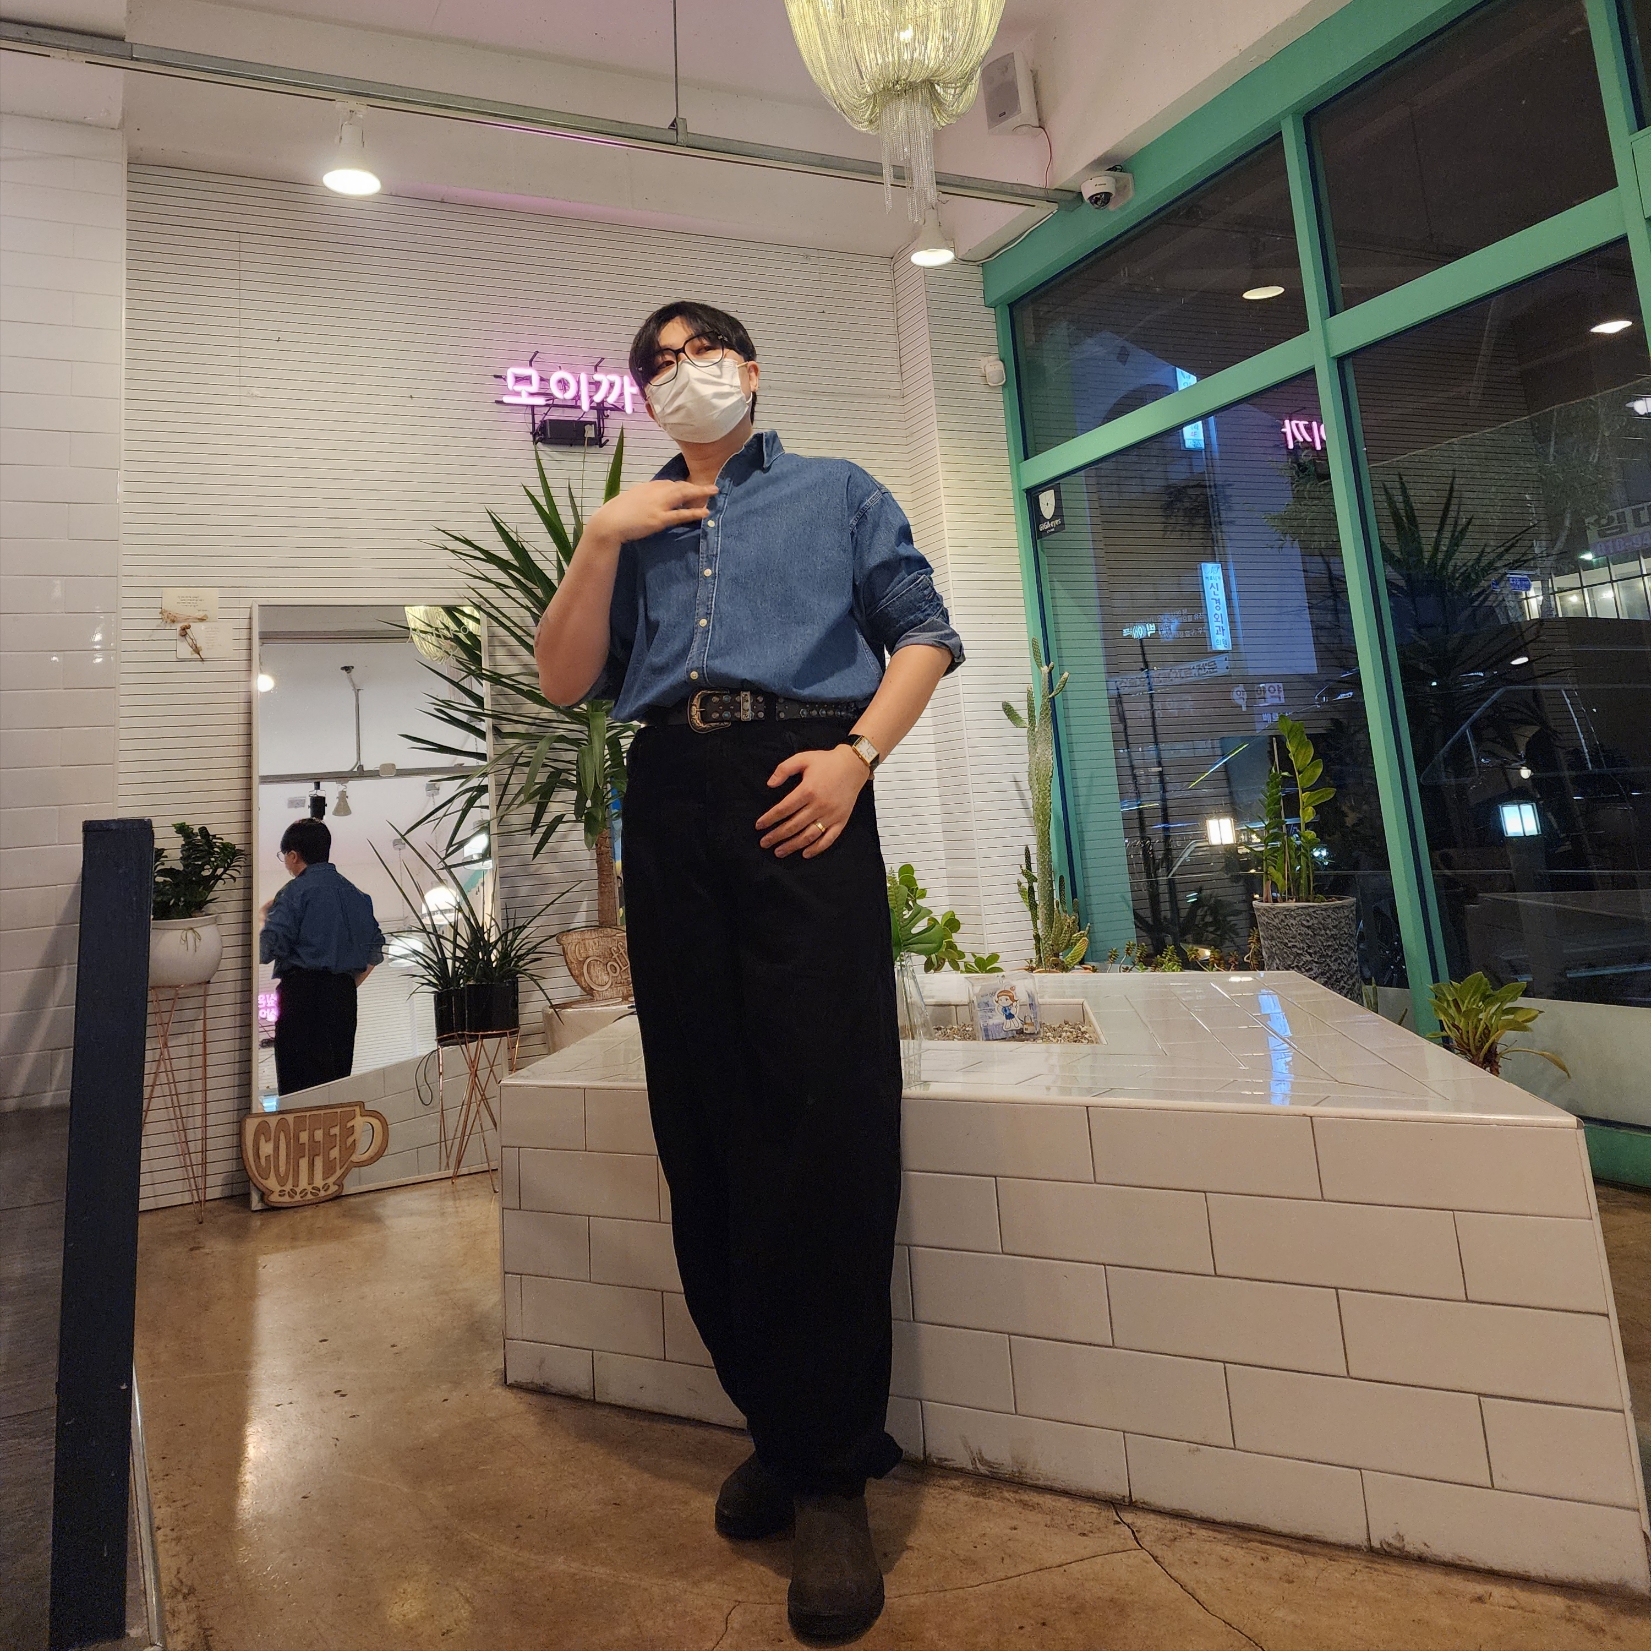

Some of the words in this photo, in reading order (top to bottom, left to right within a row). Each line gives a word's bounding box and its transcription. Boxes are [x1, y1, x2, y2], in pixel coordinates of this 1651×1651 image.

[502, 367, 637, 415] 모이까
[1209, 582, 1226, 637] 신경외과
[252, 1109, 356, 1188] COFFEE
